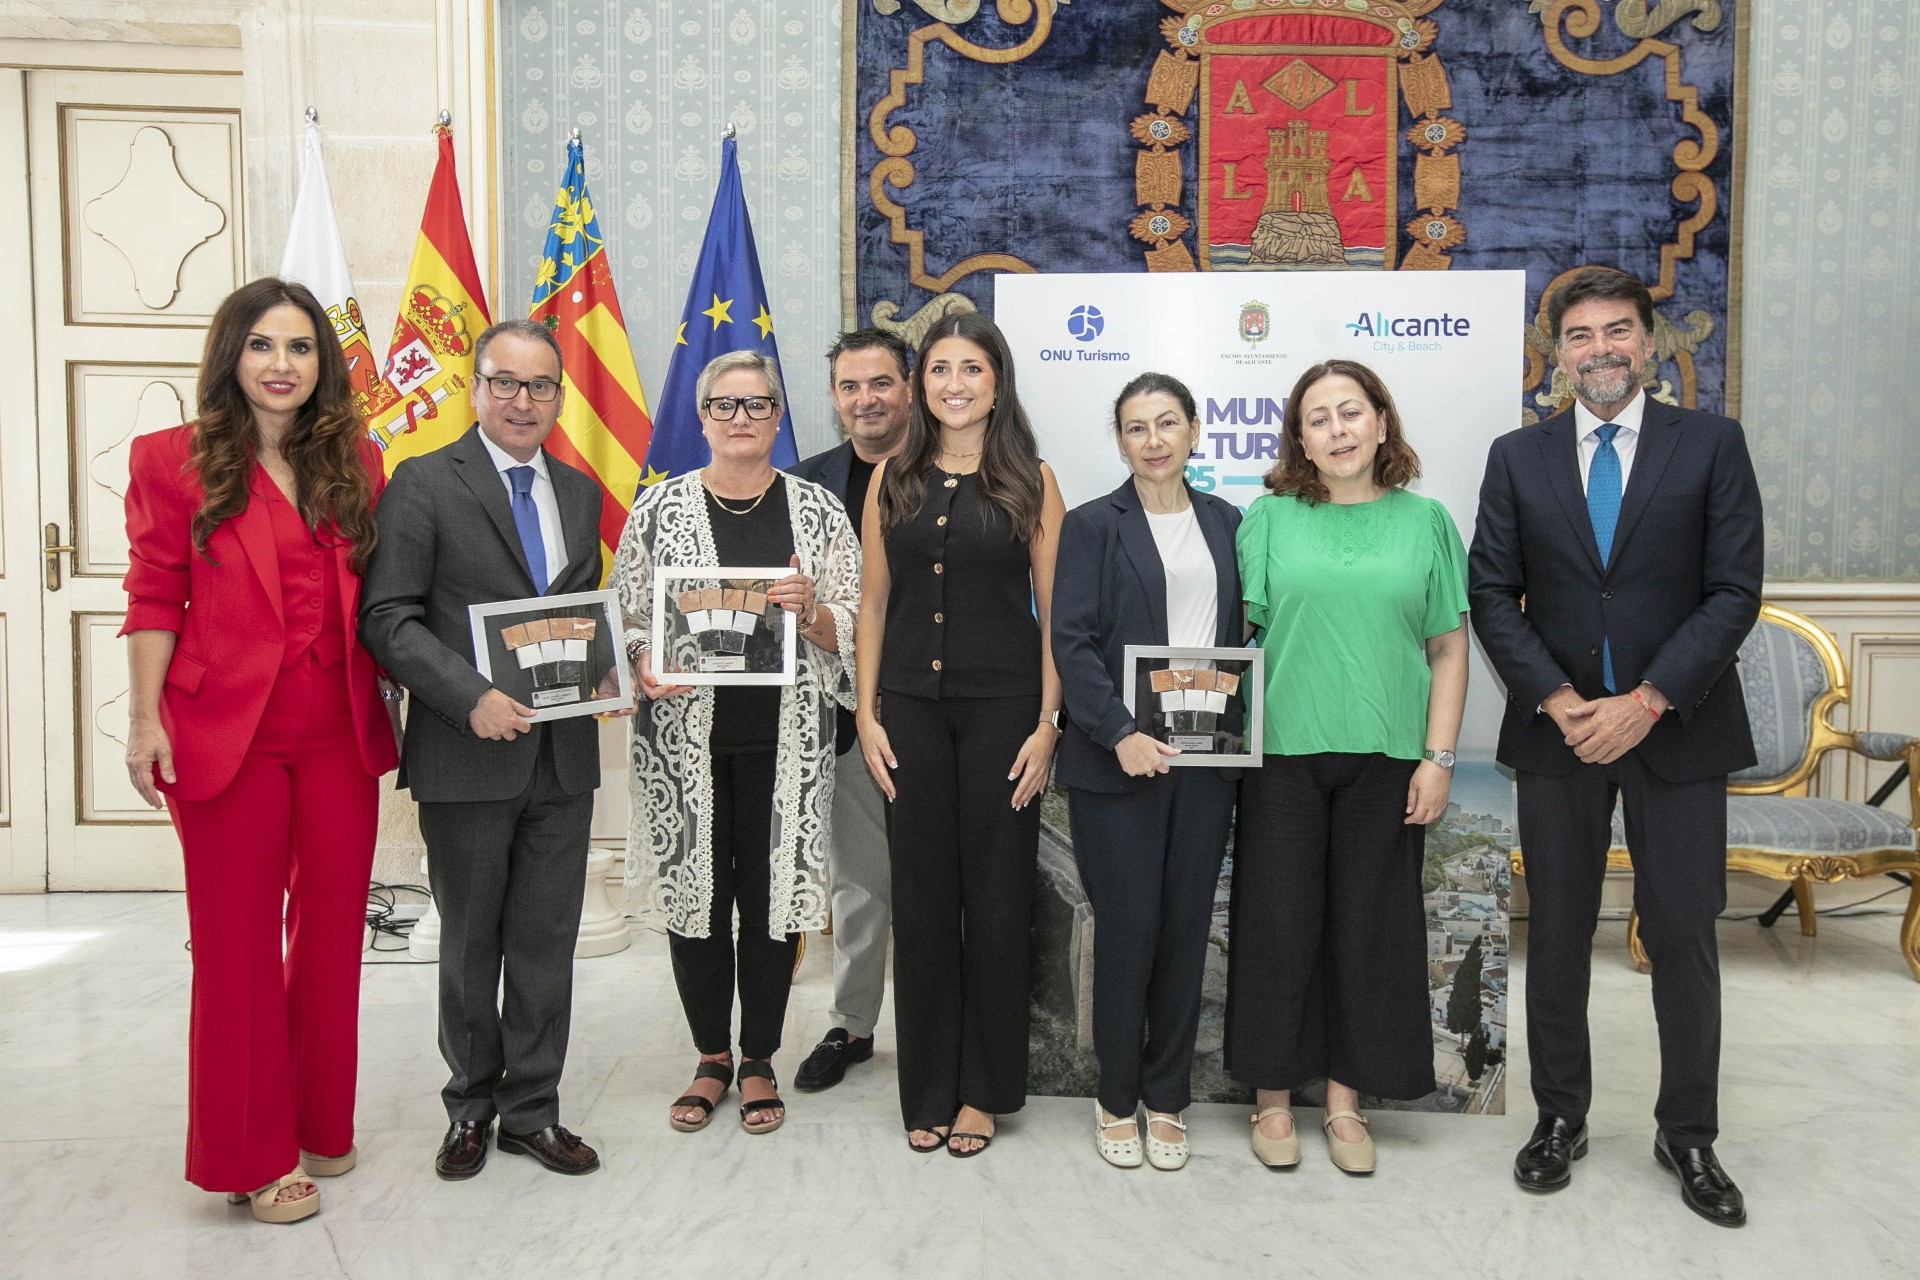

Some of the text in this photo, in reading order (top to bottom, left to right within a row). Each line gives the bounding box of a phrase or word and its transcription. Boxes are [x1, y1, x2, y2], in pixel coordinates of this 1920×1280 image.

[1223, 79, 1376, 116] A L
[1221, 163, 1374, 202] L A
[1346, 311, 1470, 337] Alicante
[1040, 349, 1130, 361] ONU Turismo
[1372, 340, 1442, 354] City & Beach
